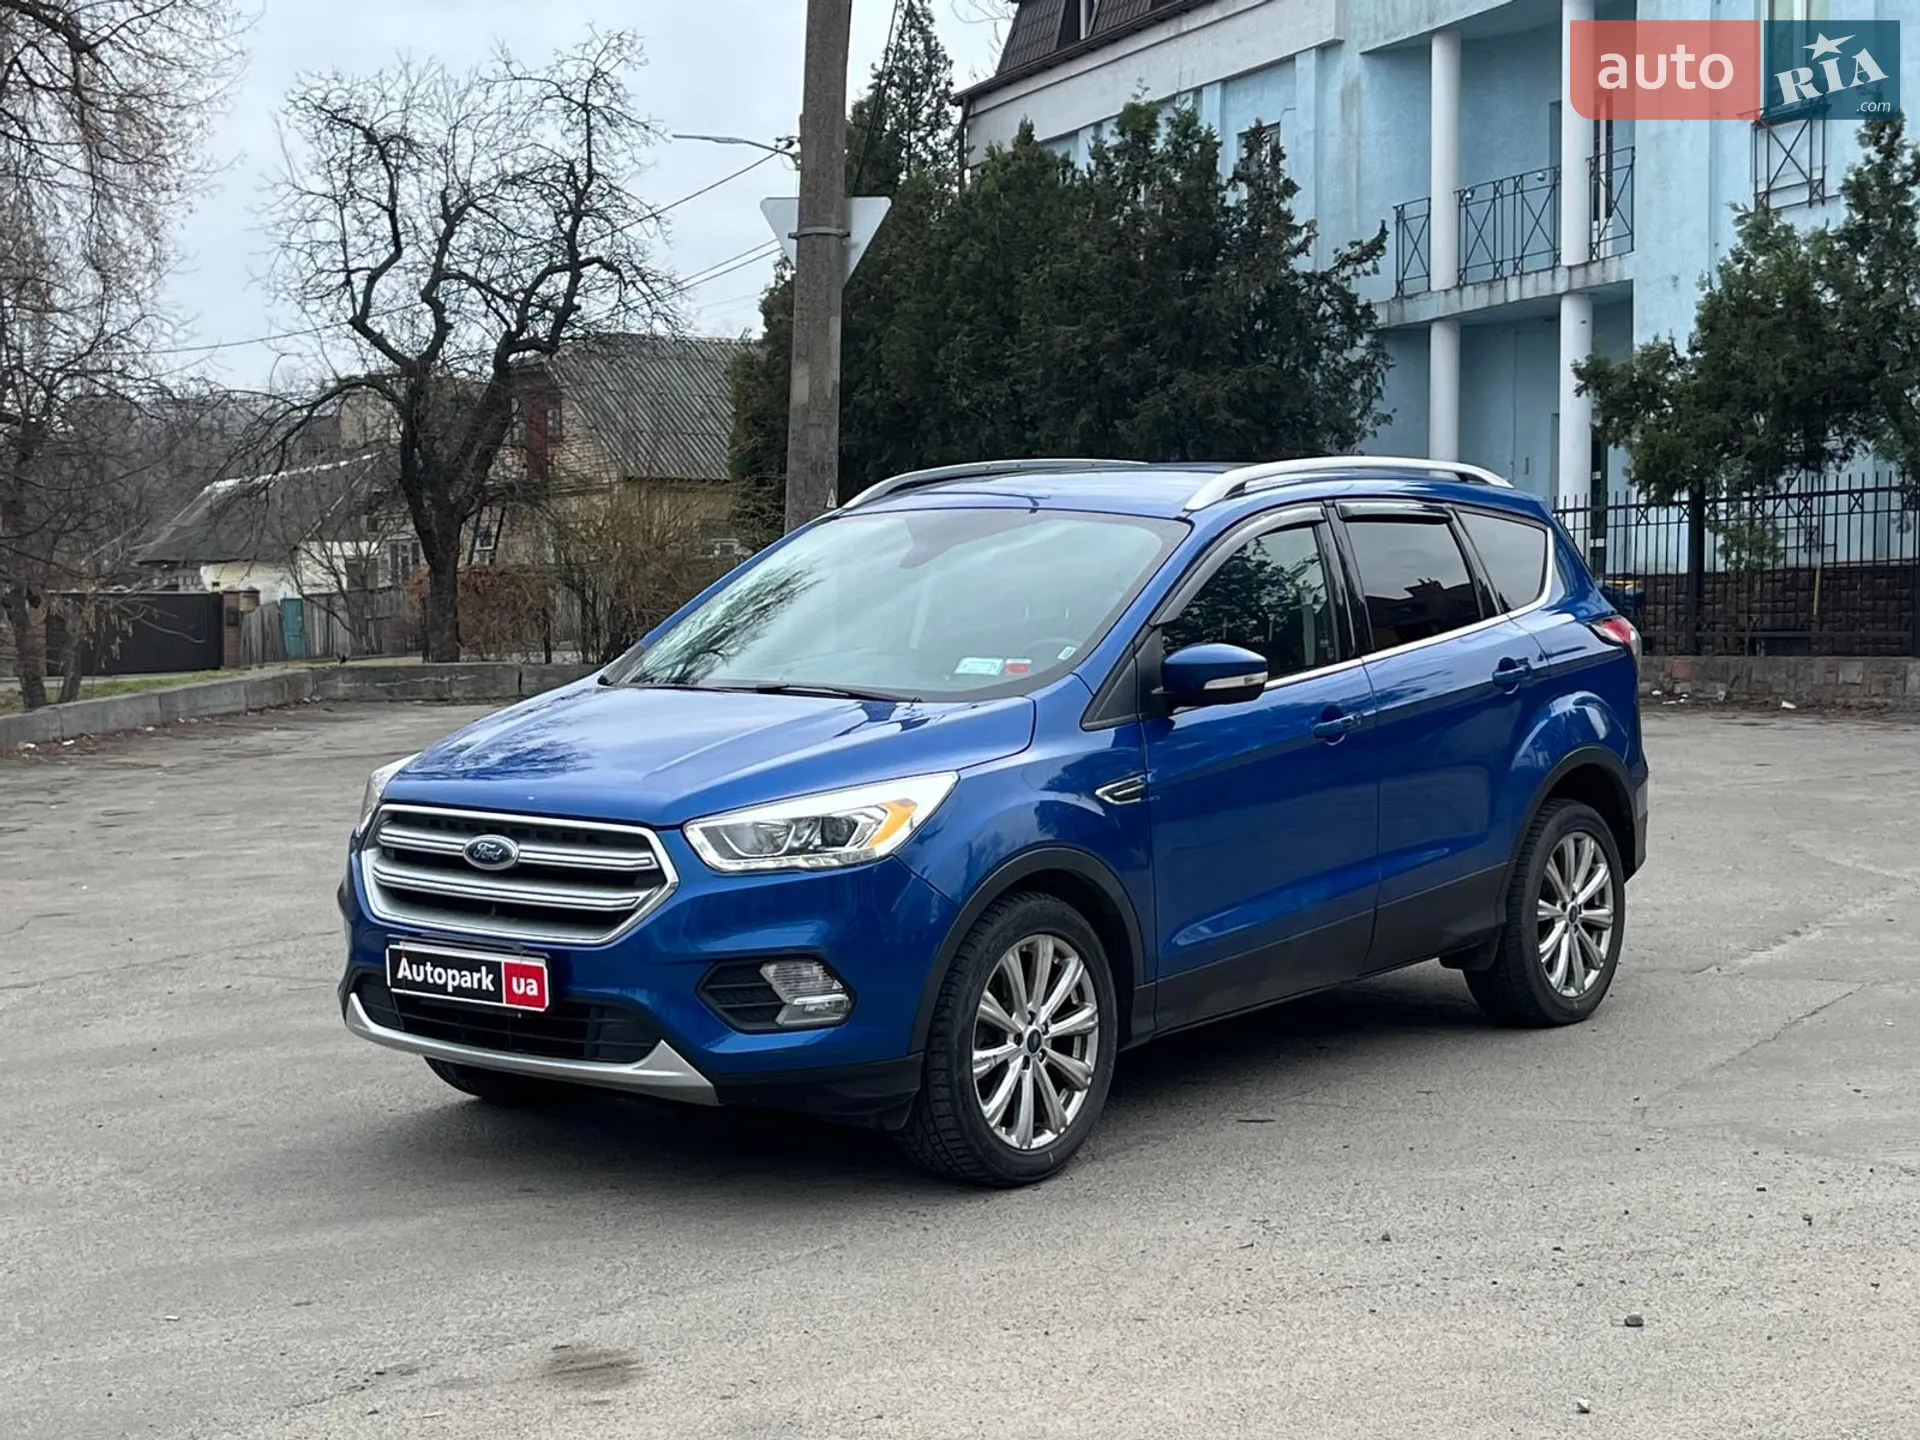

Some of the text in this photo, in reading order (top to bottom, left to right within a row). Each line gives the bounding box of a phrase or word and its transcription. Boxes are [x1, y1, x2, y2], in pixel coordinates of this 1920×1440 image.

[473, 842, 503, 860] Ford
[397, 957, 539, 996] Autopark ua
